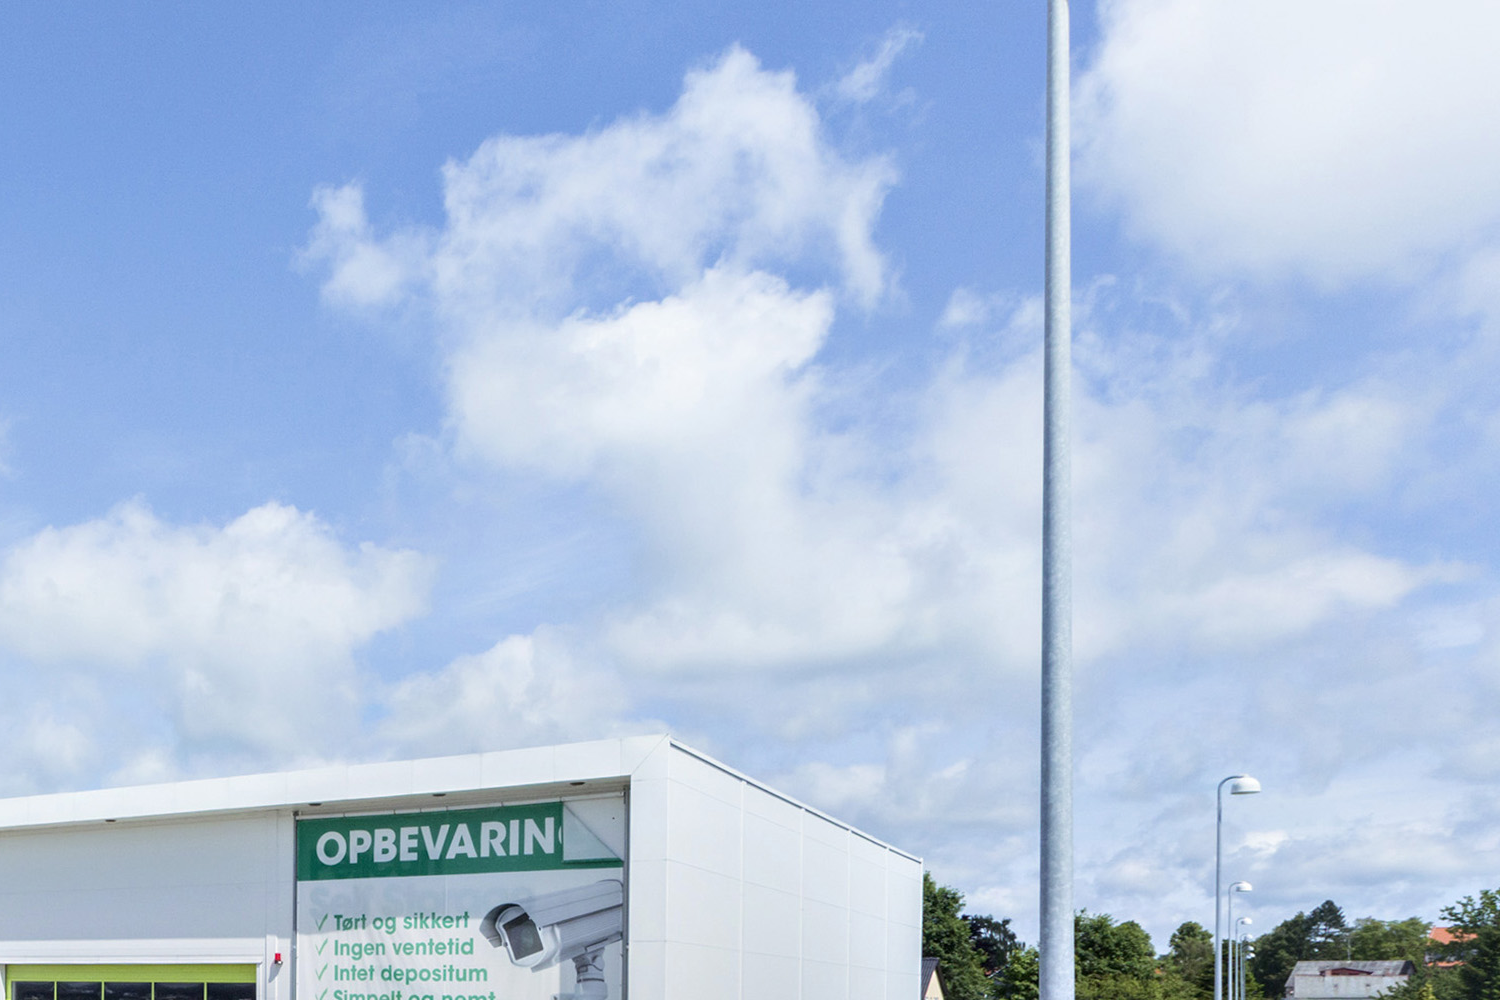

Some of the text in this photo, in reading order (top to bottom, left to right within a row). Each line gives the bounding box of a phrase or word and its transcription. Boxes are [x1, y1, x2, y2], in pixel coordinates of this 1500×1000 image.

[316, 817, 563, 866] OPBEVARIN
[333, 911, 470, 934] Tørt og sikkert
[334, 938, 474, 960] Ingen ventetid
[334, 964, 488, 985] Intet depositum
